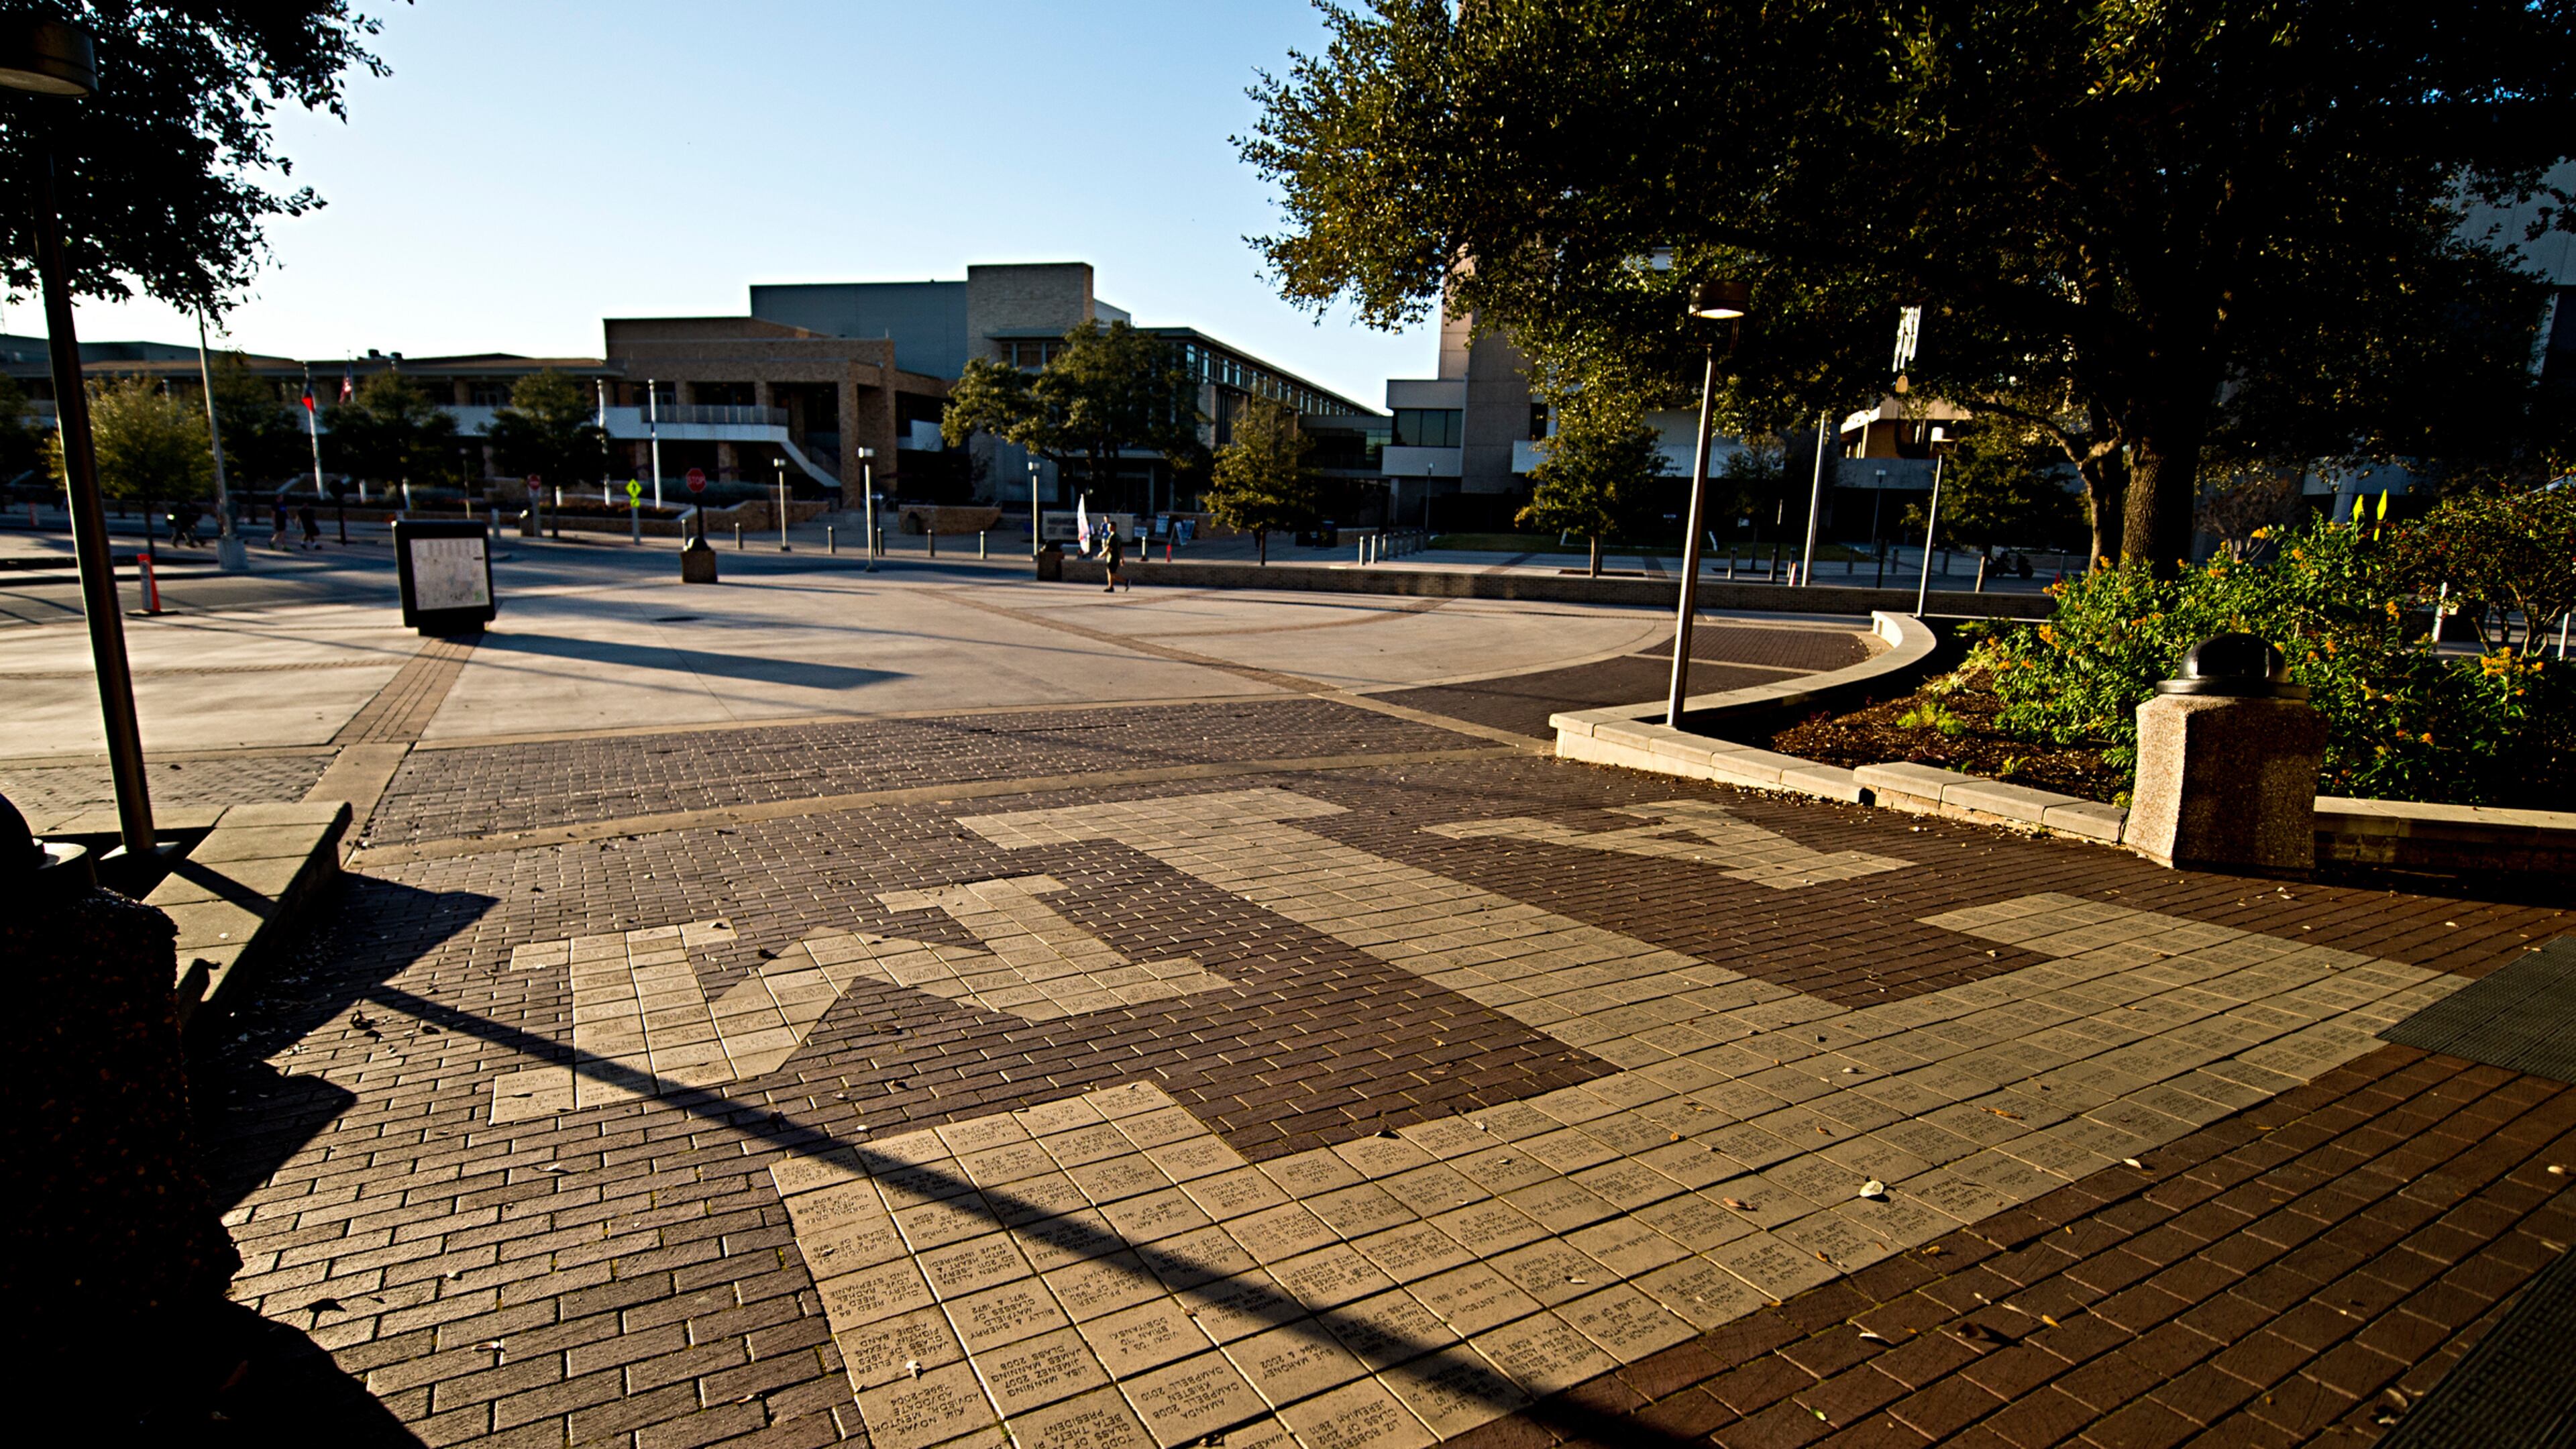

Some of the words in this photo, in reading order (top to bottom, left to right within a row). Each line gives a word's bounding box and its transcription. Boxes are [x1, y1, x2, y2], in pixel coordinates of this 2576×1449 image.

[688, 476, 704, 484] STOP
[930, 1175, 958, 1185] CLASS
[1154, 1199, 1183, 1210] CLASS
[1073, 1216, 1104, 1228] ALPHA
[1138, 1208, 1173, 1221] GARCIA
[1164, 1210, 1192, 1221] JOHN
[907, 1218, 934, 1229] CLUB
[953, 1216, 991, 1230] CORPUS
[1054, 1224, 1075, 1234] CHI
[1070, 1224, 1101, 1236] CLASS
[1129, 1220, 1154, 1230] KATY
[837, 1236, 852, 1246] OF
[855, 1228, 887, 1241] CLASS
[1019, 1229, 1054, 1243] OMEGA
[1051, 1233, 1091, 1248] BROOKS
[1053, 1232, 1069, 1241] OF
[1198, 1234, 1224, 1246] LOVE
[1407, 1228, 1438, 1241] CLASS
[882, 1239, 895, 1247] IN
[978, 1242, 1009, 1254] LEAVE
[1063, 1233, 1116, 1252] MACKENZIE
[1397, 1240, 1426, 1252] CAMP
[1419, 1240, 1450, 1253] CLASS
[1756, 1242, 1786, 1255] CLASS
[835, 1243, 878, 1259] MEMORY
[983, 1249, 1008, 1260] WITH
[1033, 1248, 1061, 1260] REED
[1159, 1252, 1191, 1265] TEXAS
[1405, 1249, 1422, 1258] OF
[948, 1256, 980, 1270] HEART
[977, 1260, 1017, 1276] LAUREN
[1178, 1255, 1230, 1275] SAMANTHA
[888, 1269, 912, 1281] AND
[941, 1272, 975, 1286] ALLEN
[1111, 1273, 1144, 1288] CLASS
[1309, 1272, 1347, 1287] STOKES
[827, 1276, 885, 1297] STEPHANIE
[881, 1281, 921, 1297] SHERYL
[1056, 1281, 1093, 1296] BLAINE
[1093, 1283, 1110, 1293] OF
[1123, 1280, 1148, 1292] LISA
[1244, 1281, 1278, 1296] JASON
[1316, 1282, 1343, 1294] LOVE
[1452, 1287, 1470, 1296] OF
[1467, 1277, 1499, 1291] CLASS
[835, 1286, 877, 1303] RACHEL
[847, 1293, 877, 1307] REED
[890, 1289, 920, 1303] CLIFF
[1240, 1293, 1268, 1306] MOM
[856, 1299, 885, 1312] REED
[990, 1298, 1036, 1316] CLASSES
[1244, 1296, 1285, 1313] SANDRA
[1385, 1300, 1418, 1315] CLASS
[1611, 1296, 1644, 1311] CLASS
[970, 1312, 987, 1322] OF
[981, 1307, 1034, 1327] MAYFIELD
[1026, 1308, 1056, 1322] BILLY
[1210, 1309, 1244, 1325] ERWIN
[1368, 1311, 1387, 1321] OF
[1393, 1307, 1426, 1322] TAMMY
[1596, 1307, 1615, 1317] OF
[1635, 1310, 1665, 1324] JOHN
[895, 1322, 928, 1337] AGGIE
[967, 1322, 1011, 1340] SHERRY
[1136, 1324, 1170, 1340] BRIAN
[1387, 1316, 1428, 1334] OTHERS
[1415, 1320, 1444, 1334] DARE
[1541, 1323, 1570, 1338] PAUL
[1624, 1323, 1660, 1340] HONOR
[858, 1332, 891, 1348] BAND
[908, 1334, 944, 1350] CLASS
[1151, 1330, 1181, 1344] VICKI
[1381, 1335, 1402, 1347] DO
[1400, 1330, 1418, 1340] TO
[1608, 1336, 1628, 1346] OF
[853, 1341, 889, 1358] TEXAS
[887, 1346, 904, 1356] OF
[912, 1340, 951, 1358] JAMES
[1503, 1337, 1534, 1352] ROSE
[1548, 1340, 1586, 1358] FAMILY
[1030, 1344, 1065, 1361] CLASS
[1046, 1348, 1084, 1364] JAMES
[1311, 1347, 1336, 1361] SUE
[1564, 1346, 1601, 1364] WHERE
[856, 1358, 892, 1375] ELLER
[1033, 1357, 1082, 1379] JIMENEZ
[1256, 1354, 1286, 1369] 2002
[1258, 1356, 1312, 1380] MAHONEY
[1543, 1359, 1567, 1373] THE
[989, 1360, 1042, 1383] MANNING
[1063, 1365, 1088, 1379] LISA
[1167, 1365, 1226, 1391] CAMPBELL
[1409, 1361, 1473, 1390] LAUDERMILK
[1466, 1366, 1493, 1380] AND
[1514, 1367, 1546, 1383] ROSE
[1002, 1374, 1030, 1389] 2007
[1005, 1374, 1060, 1397] MANNING
[1424, 1375, 1470, 1397] MELISSA
[1137, 1385, 1167, 1401] 2010
[1165, 1380, 1214, 1403] KRISTEN
[1183, 1381, 1242, 1407] CAMPBELL
[891, 1390, 955, 1417] ADVOCATE
[1178, 1397, 1229, 1421] AMANDA
[943, 1406, 966, 1420] KIM
[1334, 1399, 1390, 1425] JEREMIAH
[1361, 1407, 1399, 1427] CLASS
[870, 1409, 923, 1434] MENTOR
[895, 1415, 938, 1436] NOVAK
[1040, 1407, 1105, 1436] PRESIDENT
[1091, 1413, 1124, 1430] BETA
[1342, 1421, 1363, 1435] OF
[1382, 1419, 1404, 1432] LIZ
[1050, 1424, 1089, 1444] THETA
[1093, 1422, 1131, 1441] CLASS
[1314, 1429, 1344, 1446] 2012
[1031, 1439, 1046, 1449] PI
[1071, 1436, 1089, 1449] OF
[1099, 1432, 1134, 1449] TODD
